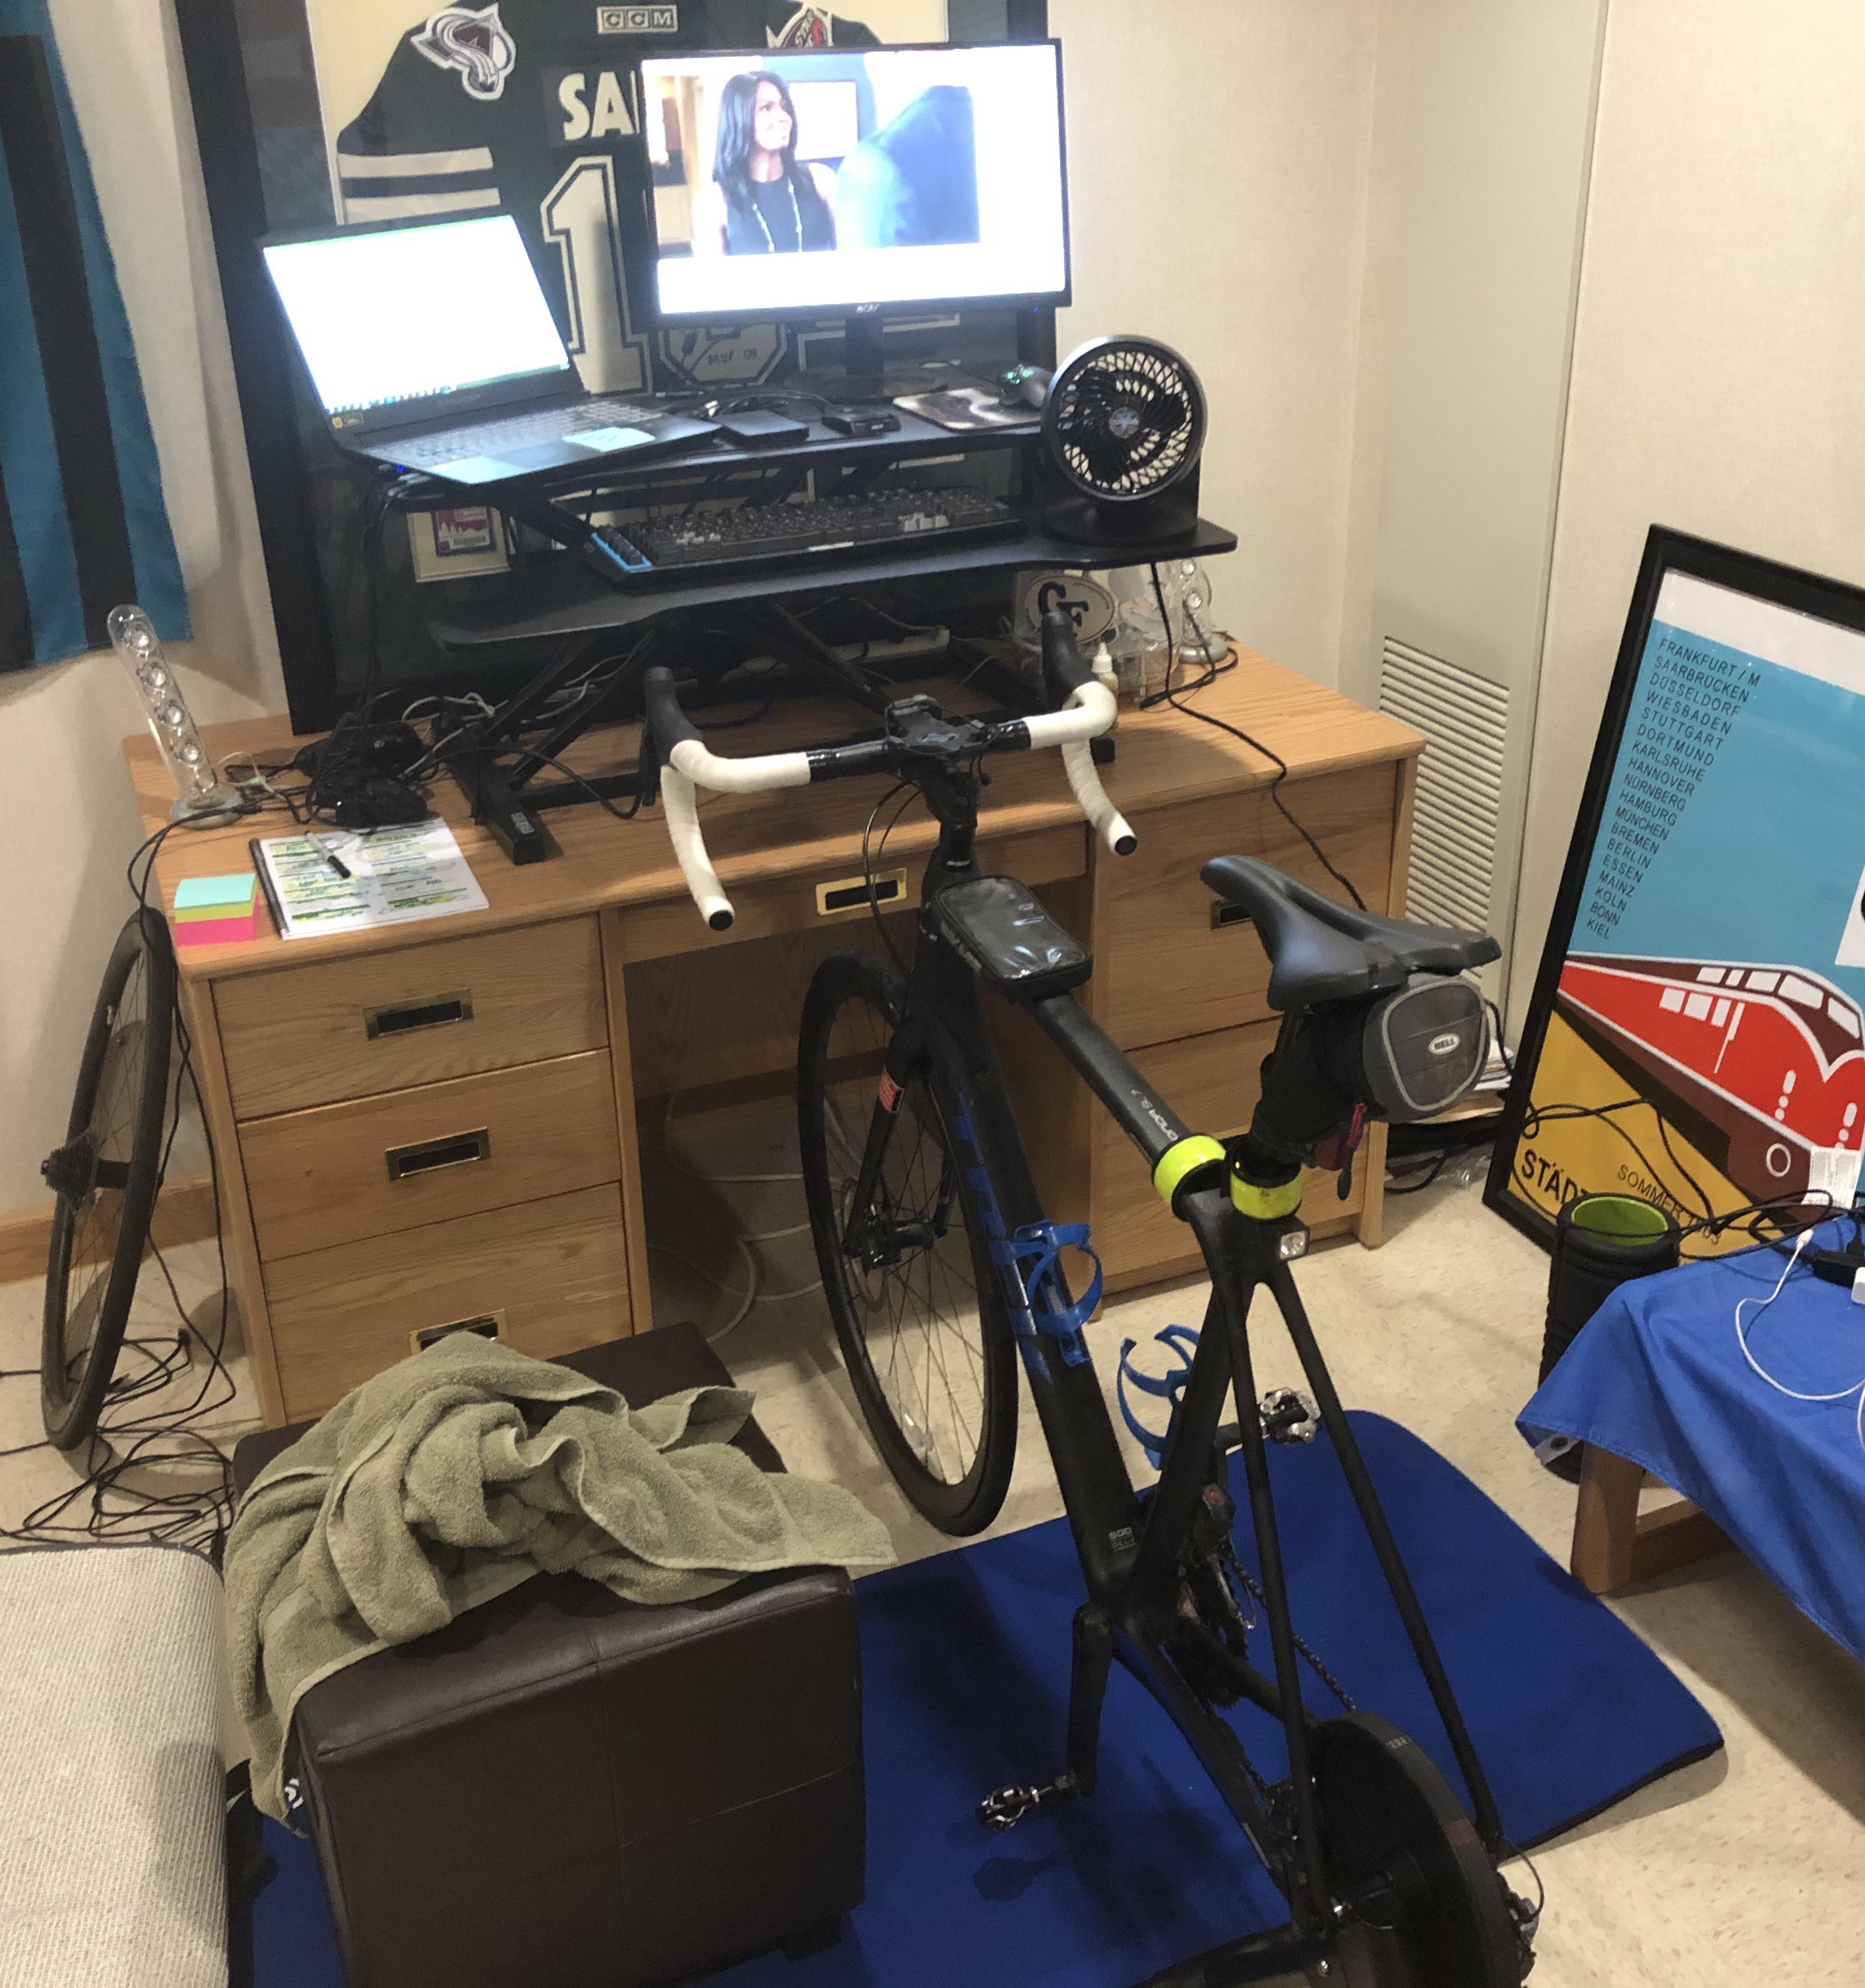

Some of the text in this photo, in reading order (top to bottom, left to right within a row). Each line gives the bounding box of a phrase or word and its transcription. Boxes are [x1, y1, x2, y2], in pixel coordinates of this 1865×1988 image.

[602, 10, 674, 28] CCM
[559, 71, 641, 140] SA
[1658, 638, 1737, 677] FRANKFURT
[1747, 672, 1761, 687] M
[1641, 707, 1724, 750] STUTTGART
[1647, 689, 1732, 734] WIESBADEN
[1632, 740, 1706, 782] KARLSRUHE
[1637, 724, 1715, 766] DORTMUND
[1628, 757, 1695, 796] HANNOVER
[1619, 789, 1678, 825] HAMBURG
[1607, 838, 1651, 869] BERLIN
[1611, 822, 1659, 854] BREMEN
[1599, 870, 1635, 897] MAINZ
[1602, 854, 1643, 883] ESSEN
[1587, 918, 1610, 940] KIEL
[1590, 901, 1621, 926] BONN
[1521, 1149, 1586, 1203] STÄD
